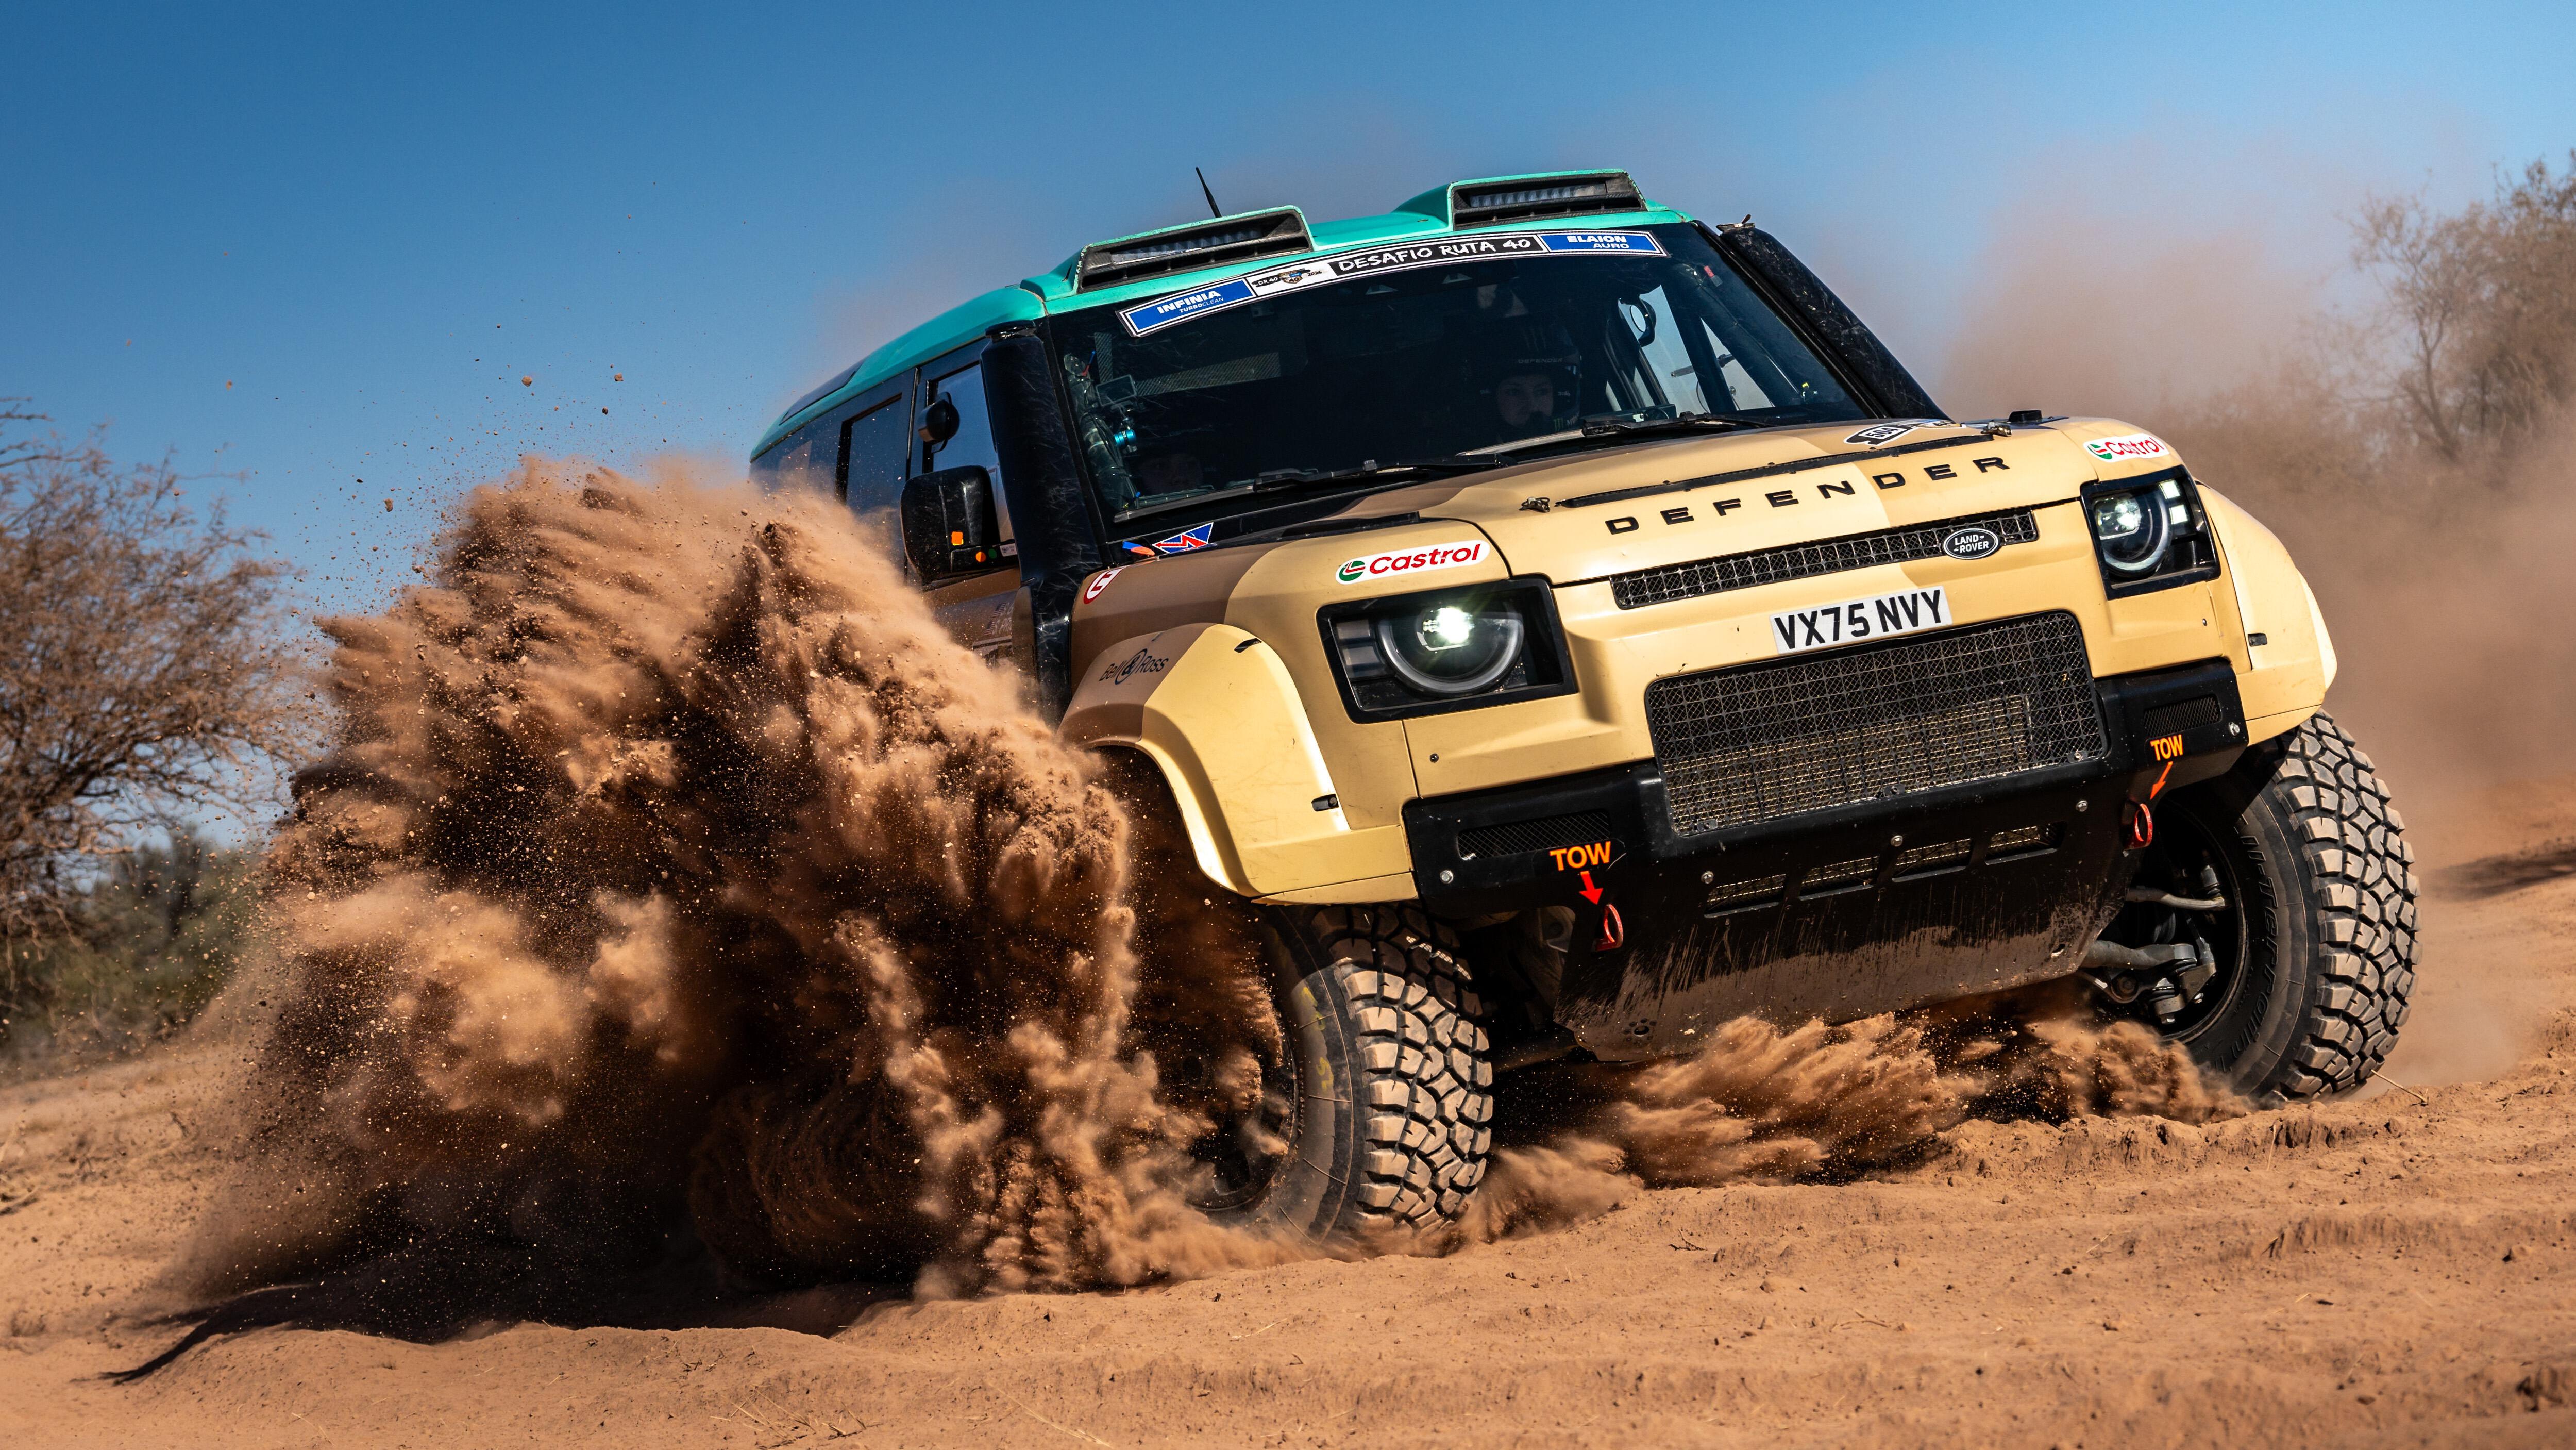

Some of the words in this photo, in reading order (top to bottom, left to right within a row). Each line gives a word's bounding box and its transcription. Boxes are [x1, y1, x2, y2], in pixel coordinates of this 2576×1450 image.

[1339, 247, 1433, 272] DESAFIO
[1438, 240, 1496, 256] RUTA
[1502, 239, 1531, 249] 40
[1157, 290, 1221, 314] INFINIA
[1178, 297, 1224, 313] TURBOCLEAN
[1864, 428, 1899, 438] 504
[1605, 457, 2010, 535] DEFENDER
[1955, 534, 1979, 545] LAND
[1960, 541, 1989, 553] ROVER
[1370, 543, 1481, 574] Castrol
[1774, 602, 1870, 649] VX75
[1875, 589, 1941, 632] NVY
[1099, 660, 1127, 681] Bell
[1136, 656, 1169, 673] Ross
[2150, 734, 2183, 761] TOW
[1550, 841, 1611, 871] TOW
